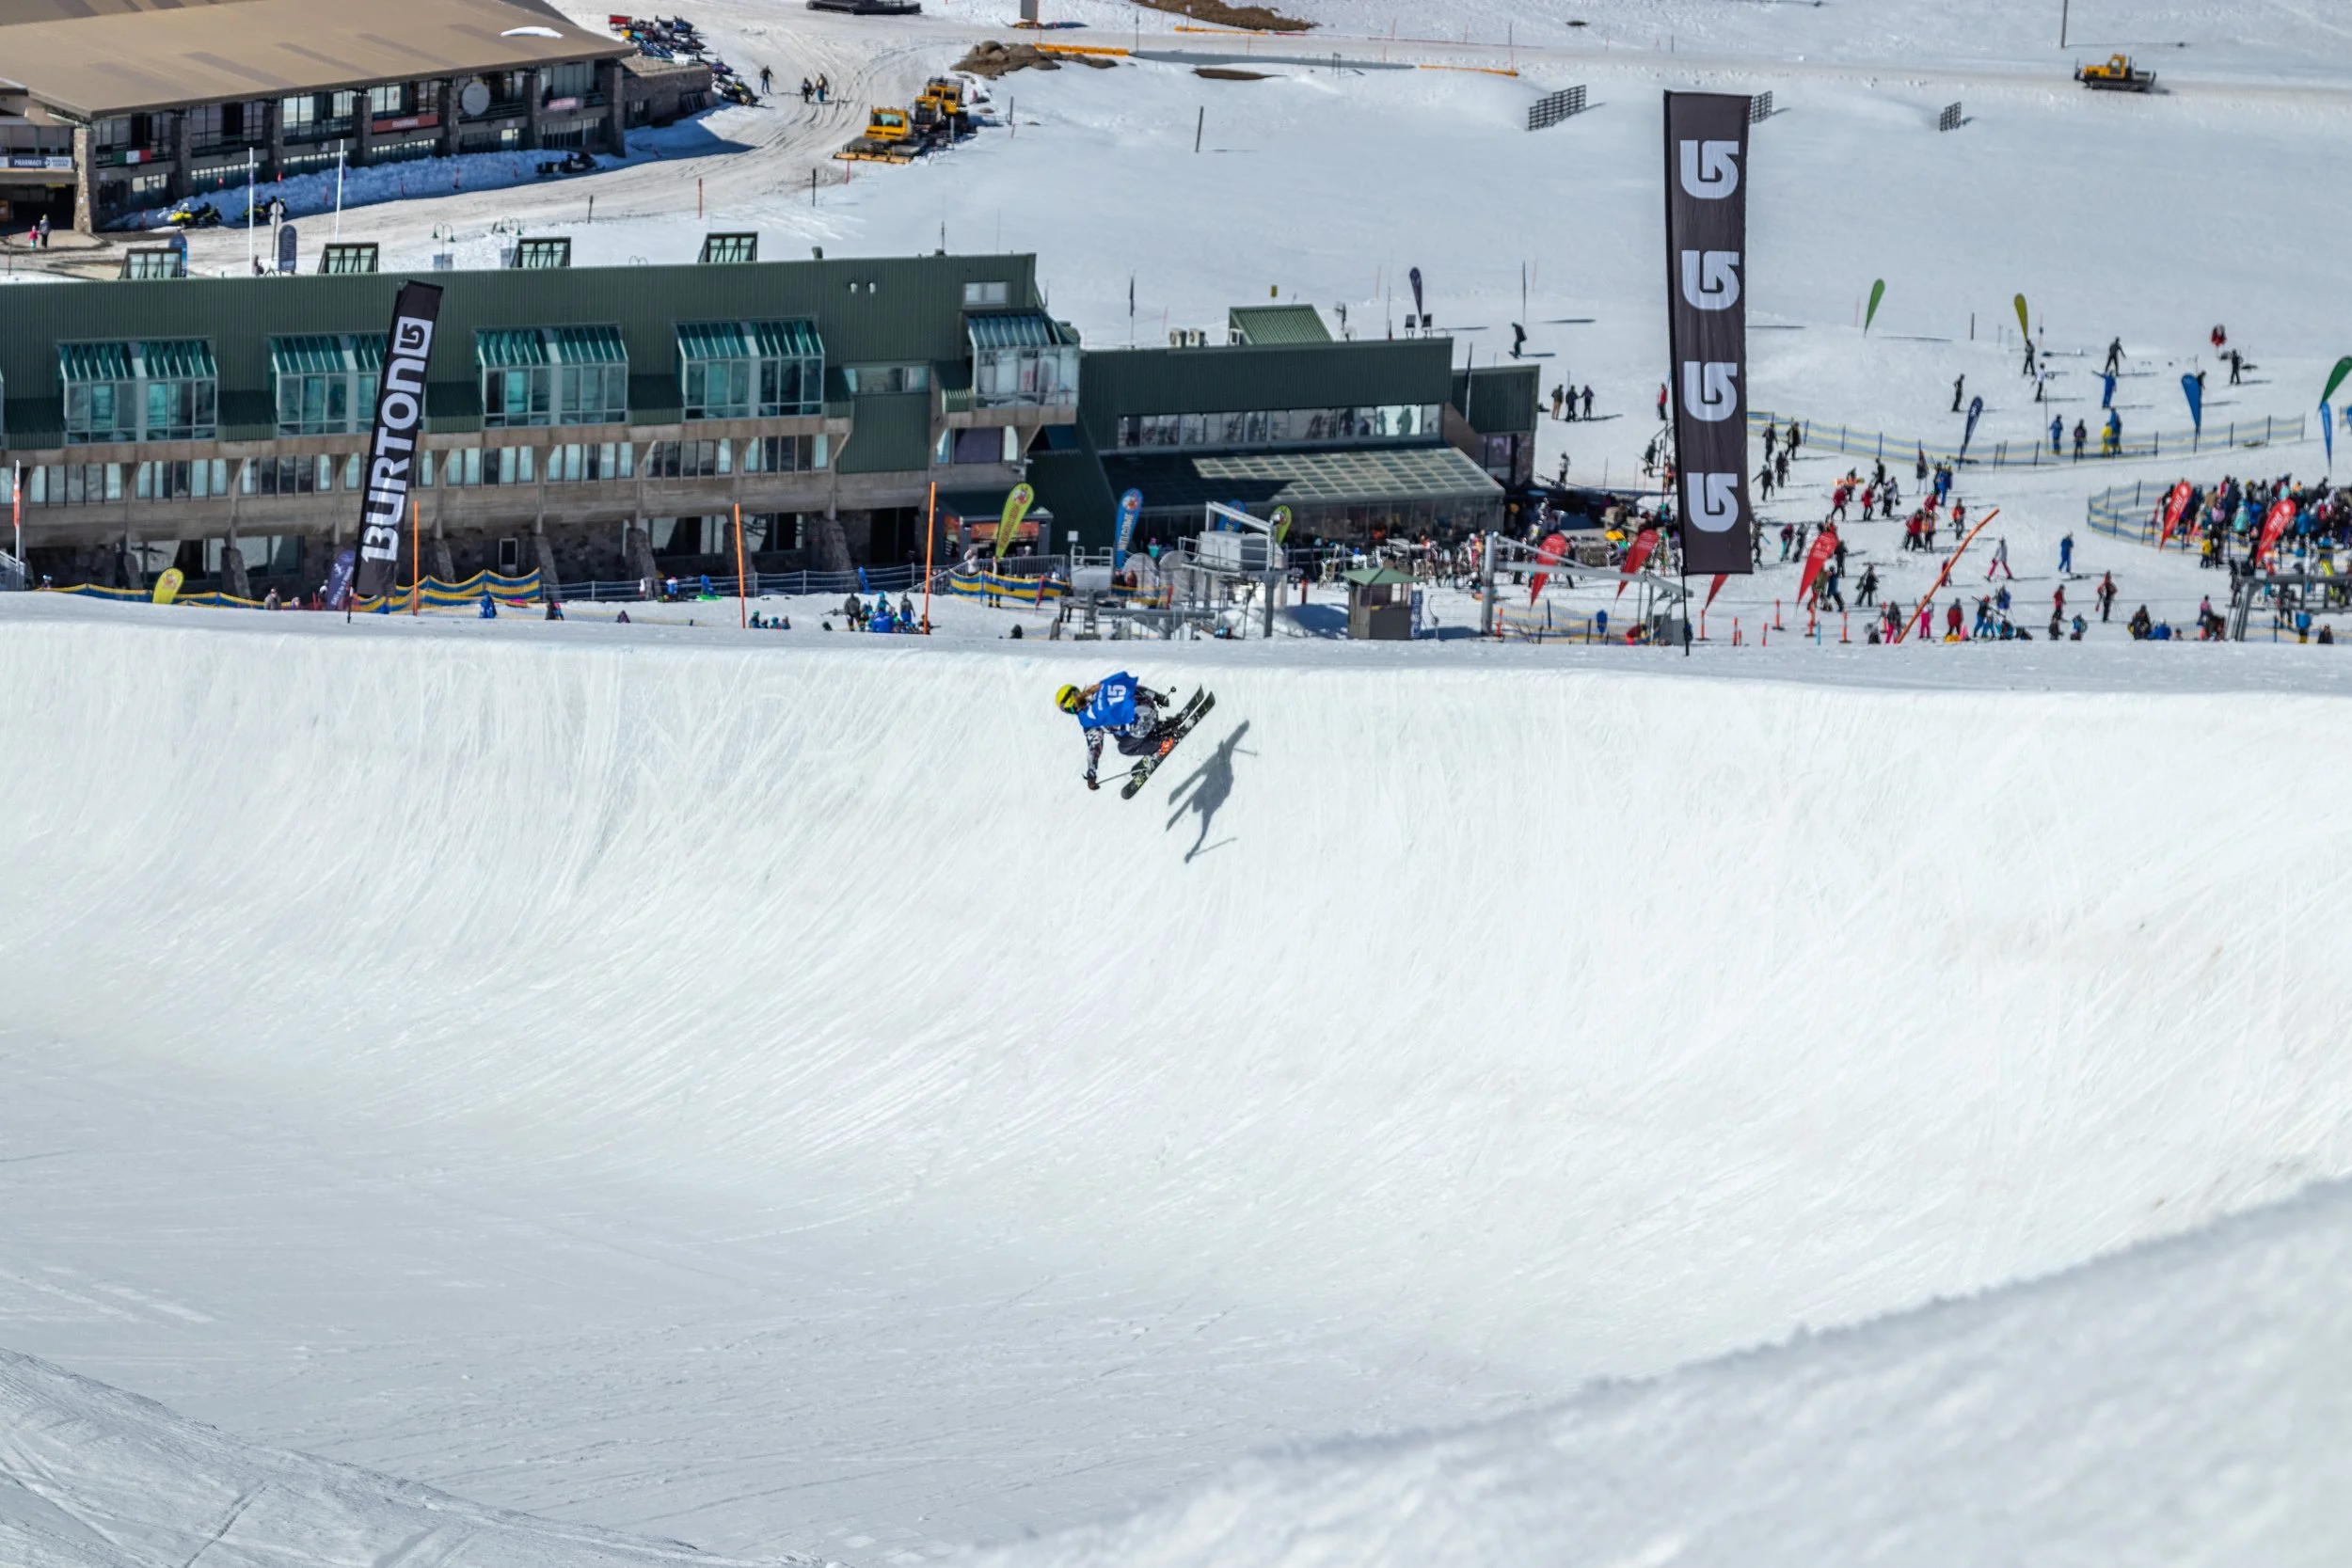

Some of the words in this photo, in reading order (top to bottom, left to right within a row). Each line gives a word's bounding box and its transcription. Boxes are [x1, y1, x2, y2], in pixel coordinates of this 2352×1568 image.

[13, 158, 42, 166] PHARMACY
[361, 357, 426, 562] BURTON
[1118, 513, 1134, 552] WELCOME
[1106, 684, 1127, 705] 15
